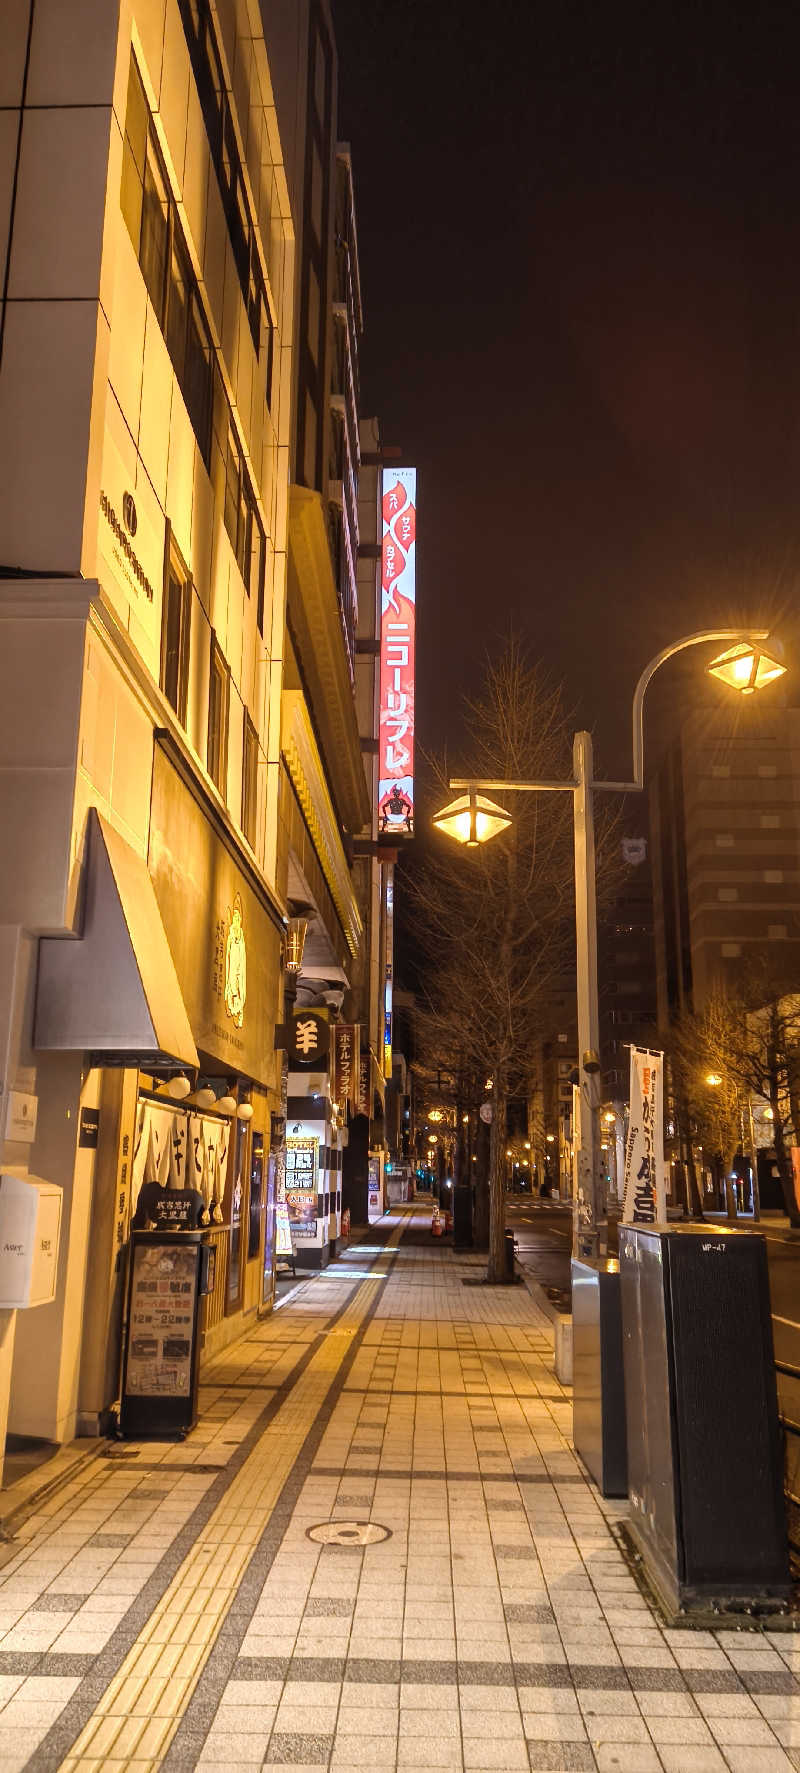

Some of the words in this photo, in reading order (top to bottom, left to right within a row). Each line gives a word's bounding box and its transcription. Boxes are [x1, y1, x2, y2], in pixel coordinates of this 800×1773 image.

[388, 493, 399, 510] スパ
[401, 516, 412, 541] サウナ
[385, 545, 396, 578] カプセル
[385, 622, 411, 770] ニコーリフレ
[295, 1019, 318, 1055] 羊
[338, 1033, 352, 1095] ホテルファラオ
[625, 1126, 639, 1169] Sapporo
